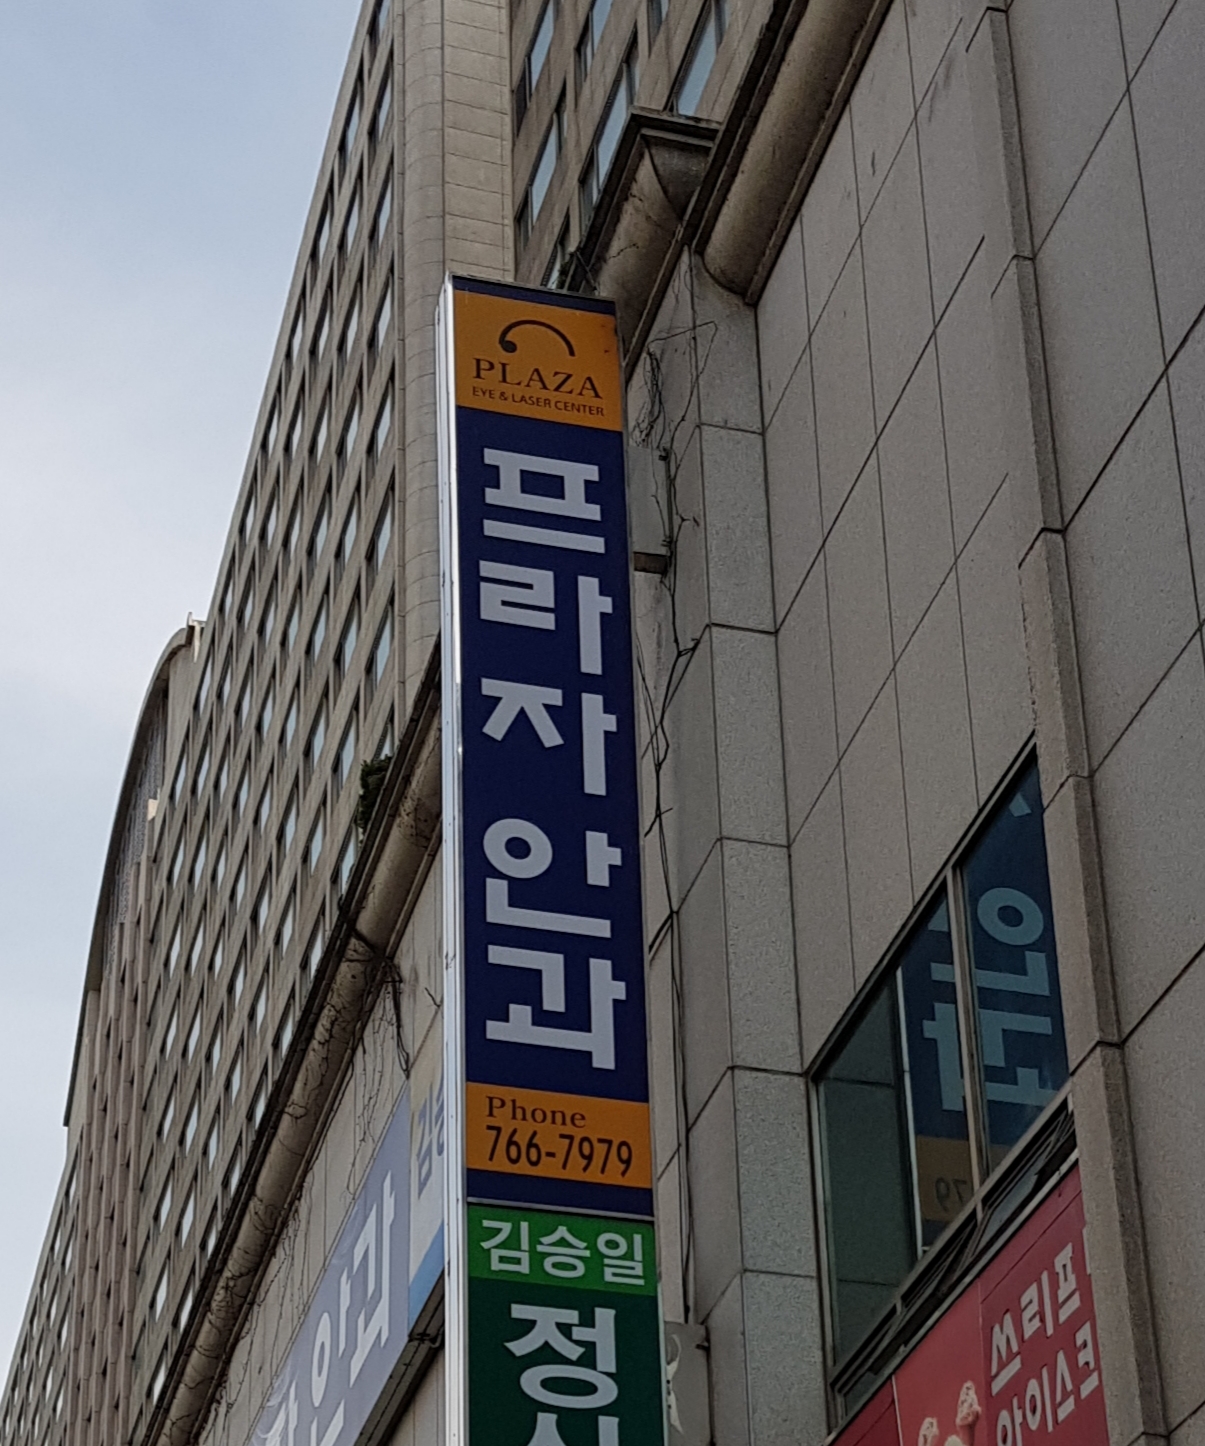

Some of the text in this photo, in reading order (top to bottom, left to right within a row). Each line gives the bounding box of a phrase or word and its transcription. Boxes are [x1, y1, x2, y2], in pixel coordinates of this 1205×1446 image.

[472, 357, 603, 400] PLAZA
[472, 386, 605, 417] EYE & LASER CENTER
[478, 446, 627, 1070] 프라자안과
[485, 1095, 587, 1128] Phone
[485, 1125, 633, 1178] 766-7979
[480, 1219, 645, 1286] 김승일
